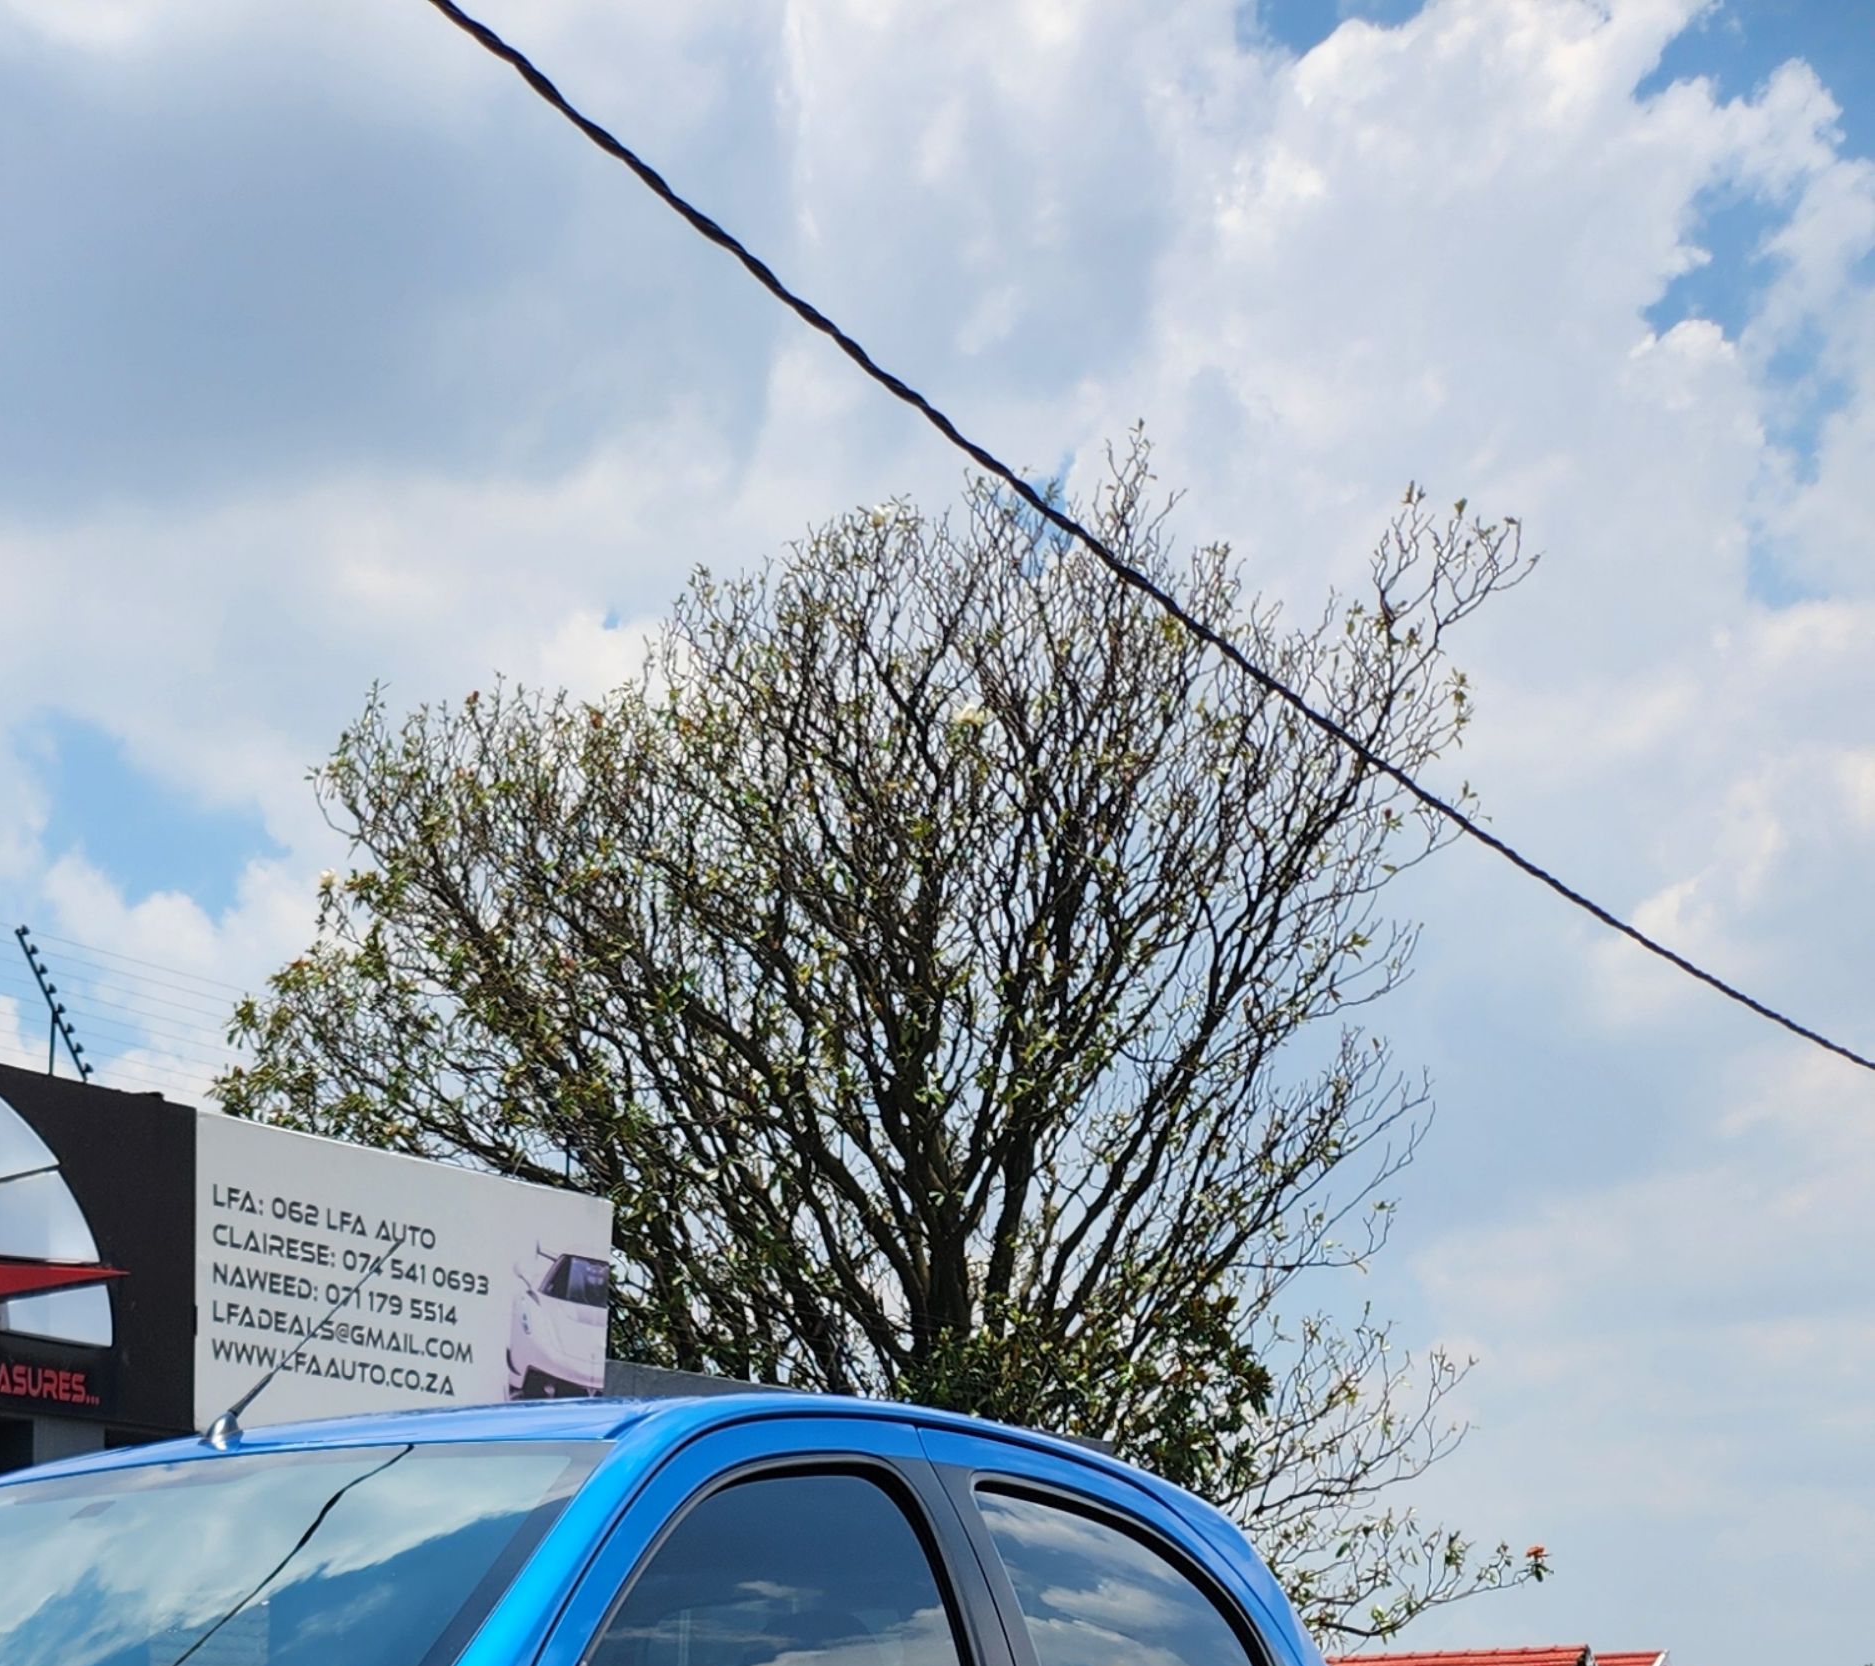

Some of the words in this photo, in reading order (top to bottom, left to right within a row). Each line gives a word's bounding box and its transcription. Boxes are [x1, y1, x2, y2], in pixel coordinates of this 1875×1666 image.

[213, 1184, 264, 1216] LFA:
[271, 1197, 319, 1227] 062
[327, 1208, 367, 1237] LFA
[375, 1220, 436, 1250] AUTO
[212, 1223, 335, 1268] CLAIRESE:
[341, 1249, 383, 1277] 074
[390, 1258, 426, 1285] 541
[432, 1266, 489, 1296] 0693
[213, 1262, 318, 1302] NAWEED:
[325, 1283, 362, 1310] 071
[368, 1290, 403, 1316] 179
[410, 1298, 458, 1326] 5514
[212, 1300, 474, 1364] LFADEALS@GMAIL.COM
[211, 1338, 455, 1396] WWWLFAAUTO.CO.ZA
